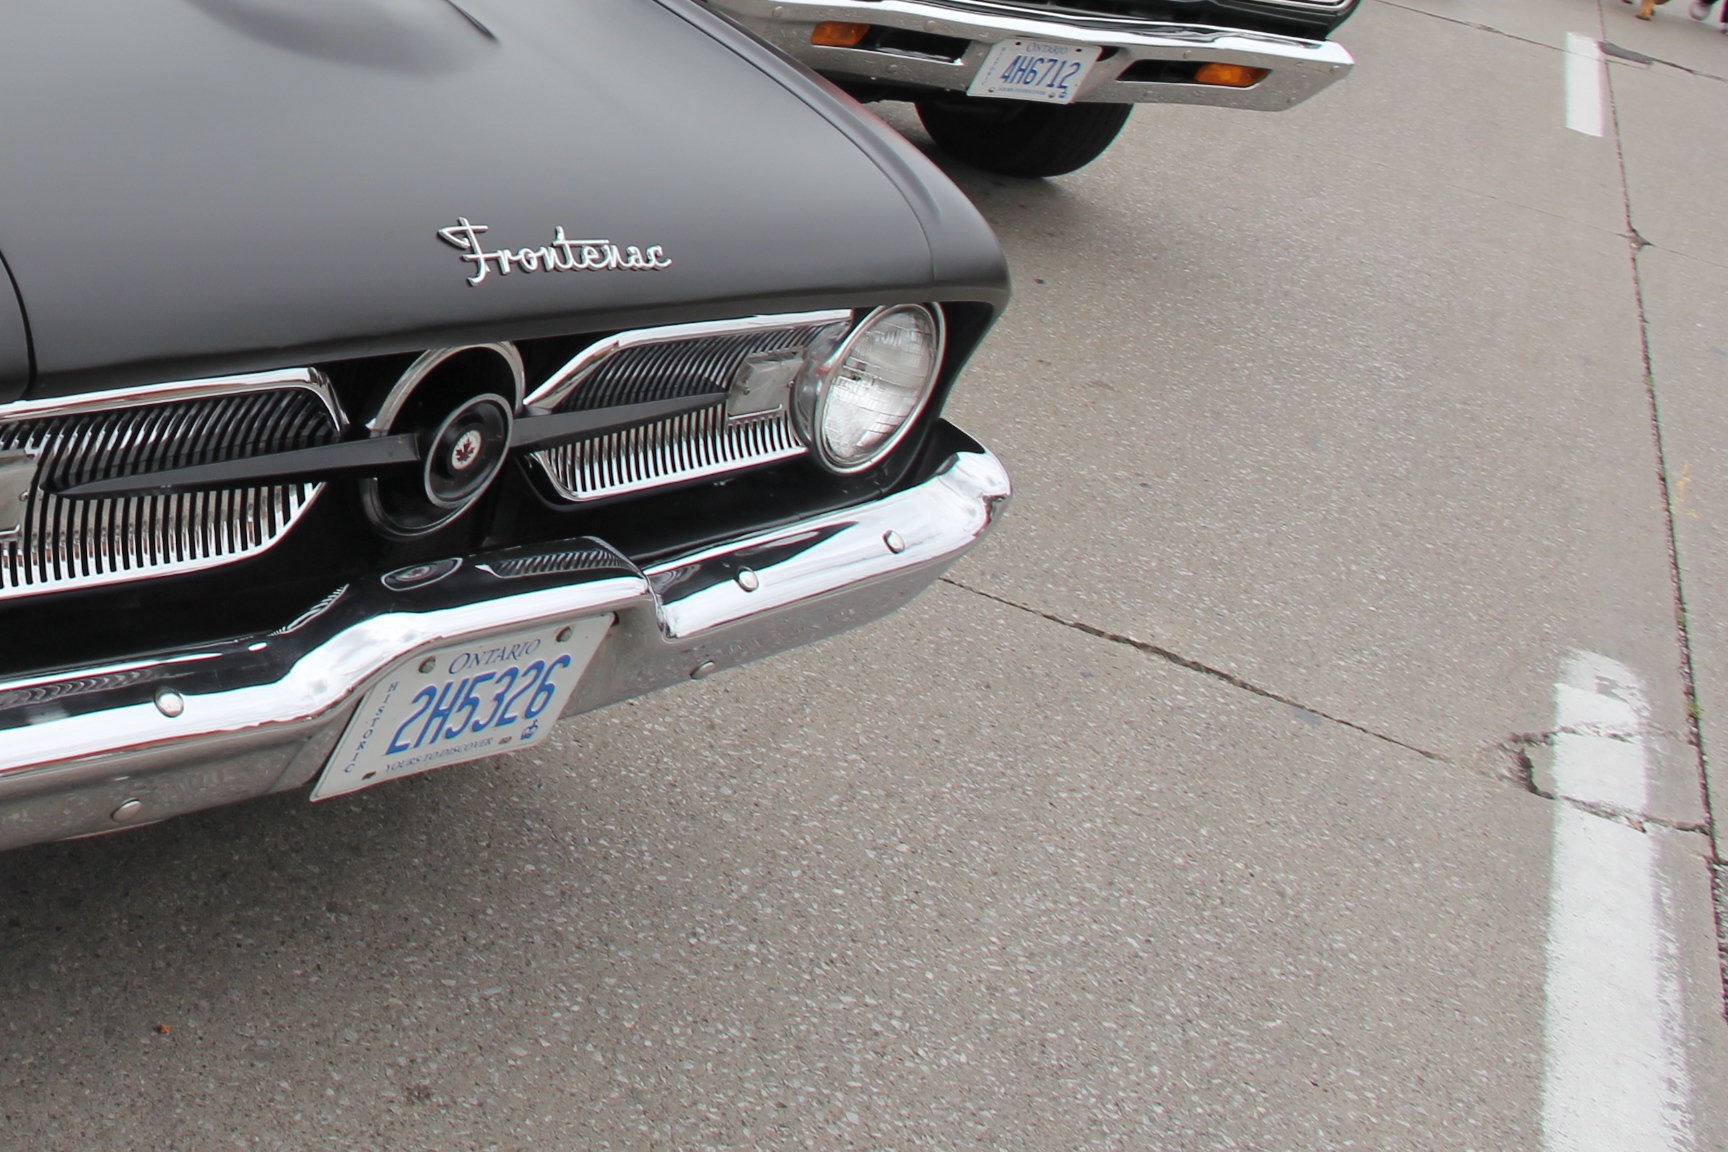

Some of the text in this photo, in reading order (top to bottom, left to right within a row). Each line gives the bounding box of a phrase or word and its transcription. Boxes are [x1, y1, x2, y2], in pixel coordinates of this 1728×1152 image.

[1000, 55, 1082, 90] 4H6712
[438, 216, 674, 288] Frontenac
[448, 638, 542, 675] ONTARIO
[385, 654, 572, 756] 2H5326
[385, 737, 494, 773] YOURS TO DISCOVER
